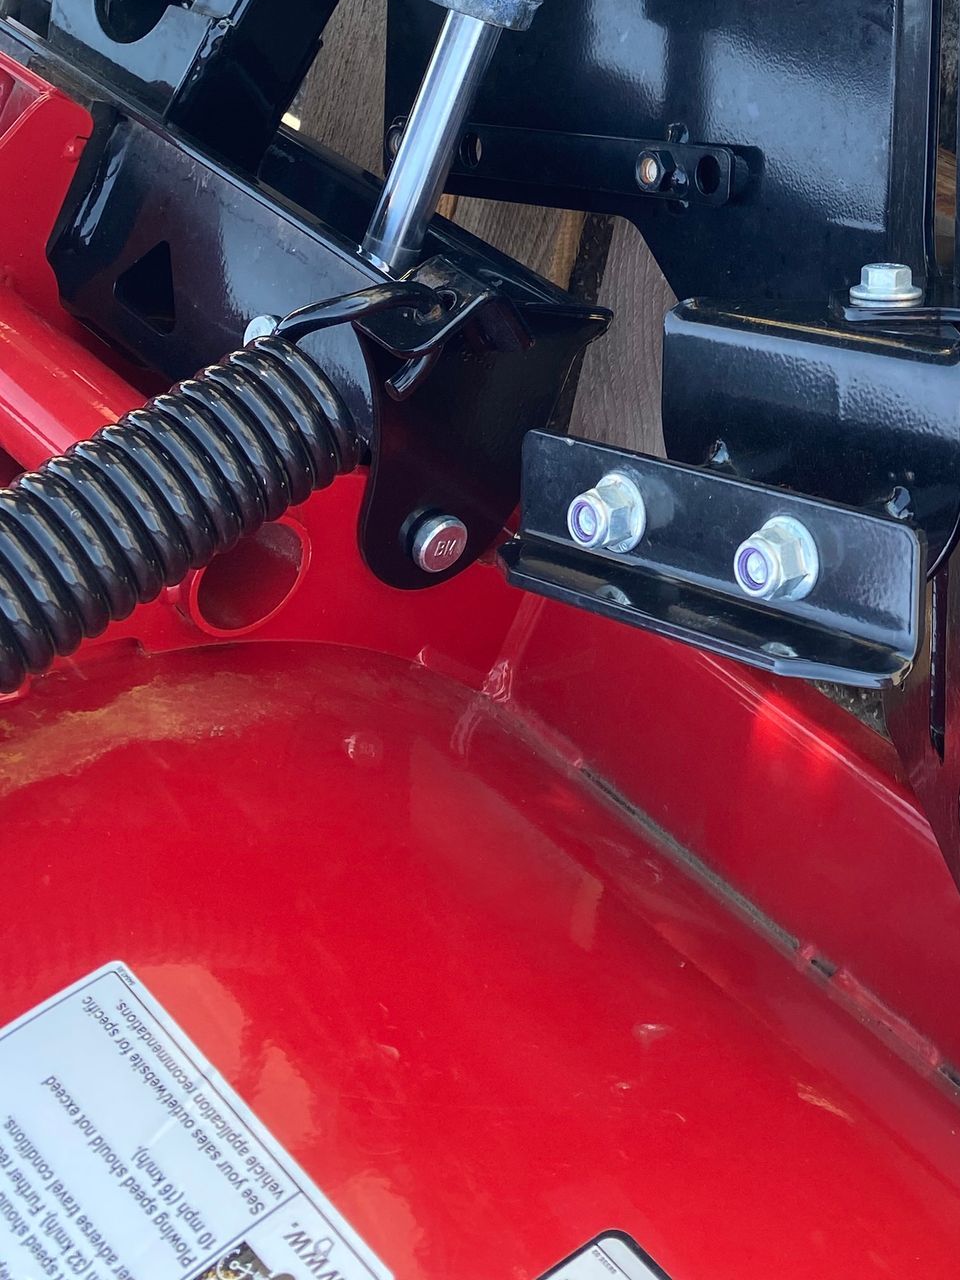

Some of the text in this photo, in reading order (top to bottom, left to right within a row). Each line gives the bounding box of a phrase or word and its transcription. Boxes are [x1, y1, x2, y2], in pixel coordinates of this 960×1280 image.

[81, 995, 267, 1217] See your sales outlet/website for specific
[115, 998, 287, 1201] vehicle application recommendations.
[2, 1114, 55, 1182] conditions.
[39, 1074, 199, 1270] Plowing speed should not exceed
[4, 1167, 47, 1218] Further
[44, 1178, 82, 1219] travel
[130, 1145, 218, 1251] 10 mph (16 km/h).
[20, 1233, 60, 1278] speed
[38, 1210, 76, 1257] km/h).
[74, 1214, 120, 1267] adverse
[64, 1248, 94, 1277] (32
